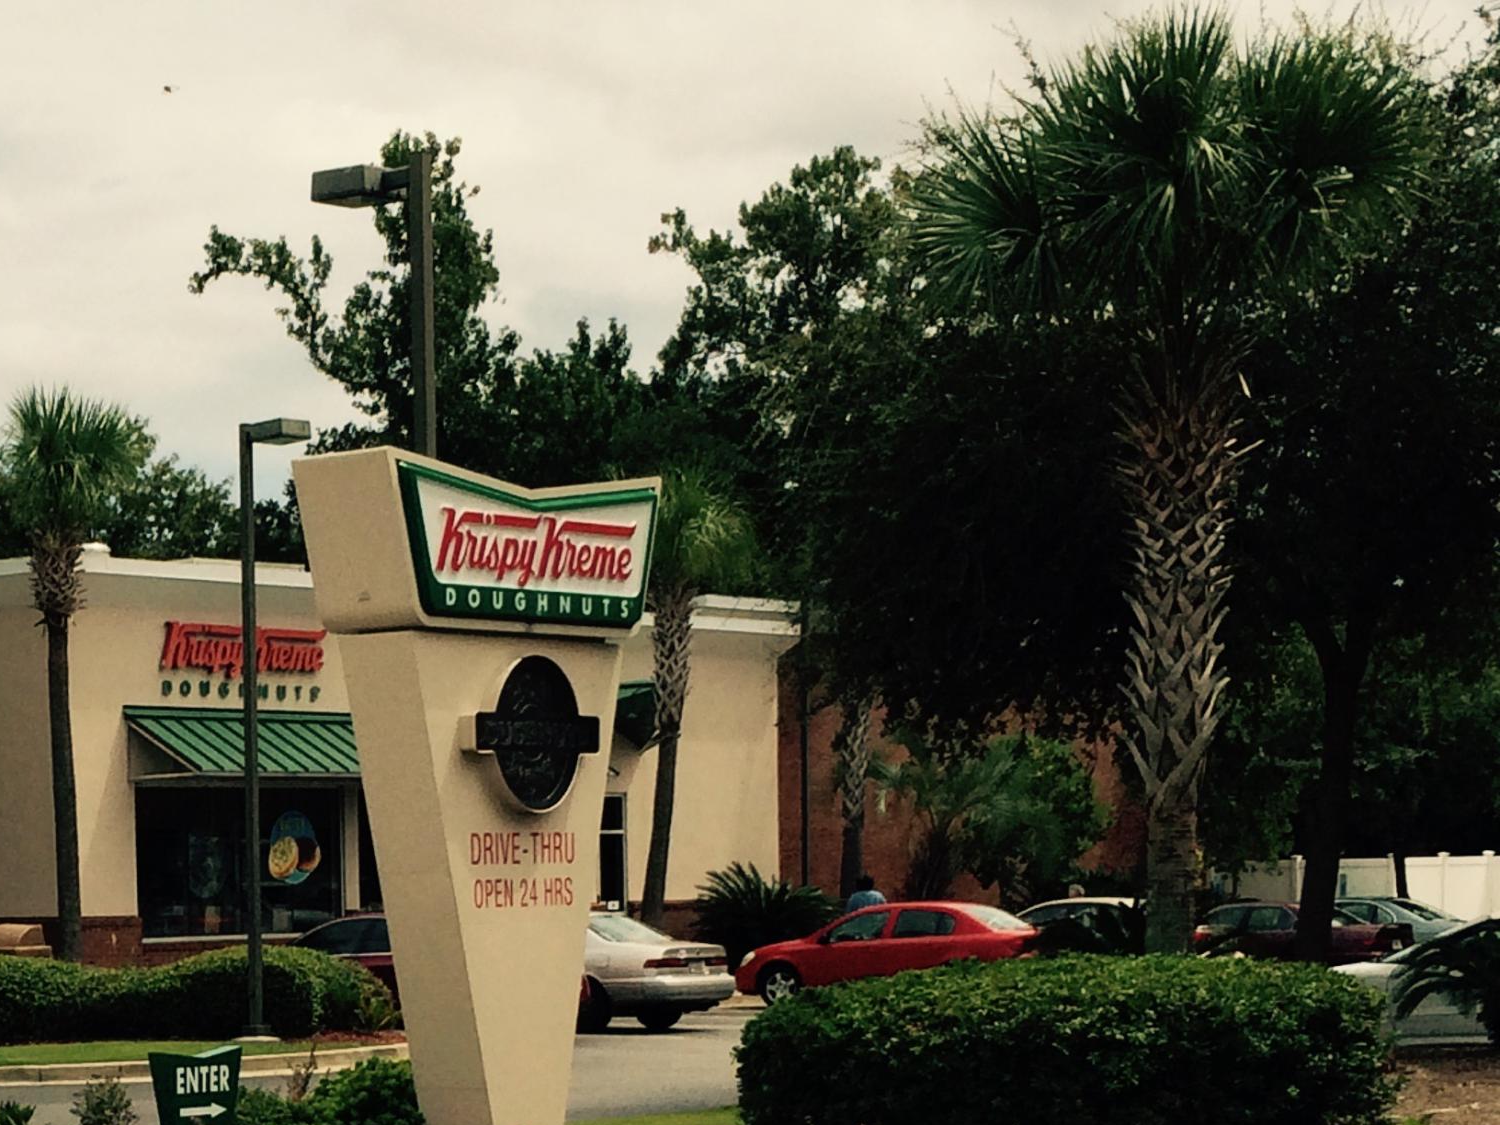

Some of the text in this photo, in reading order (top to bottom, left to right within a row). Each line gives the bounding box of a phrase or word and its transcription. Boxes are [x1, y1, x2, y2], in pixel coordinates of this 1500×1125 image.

[436, 507, 637, 587] Krispy Kreme
[445, 587, 629, 618] DOUGHNUTS
[162, 621, 328, 679] Krispy Kreme
[470, 831, 575, 865] DRIVE-THRU
[474, 877, 573, 908] OPEN 24 HRS
[176, 1064, 230, 1095] ENTER
